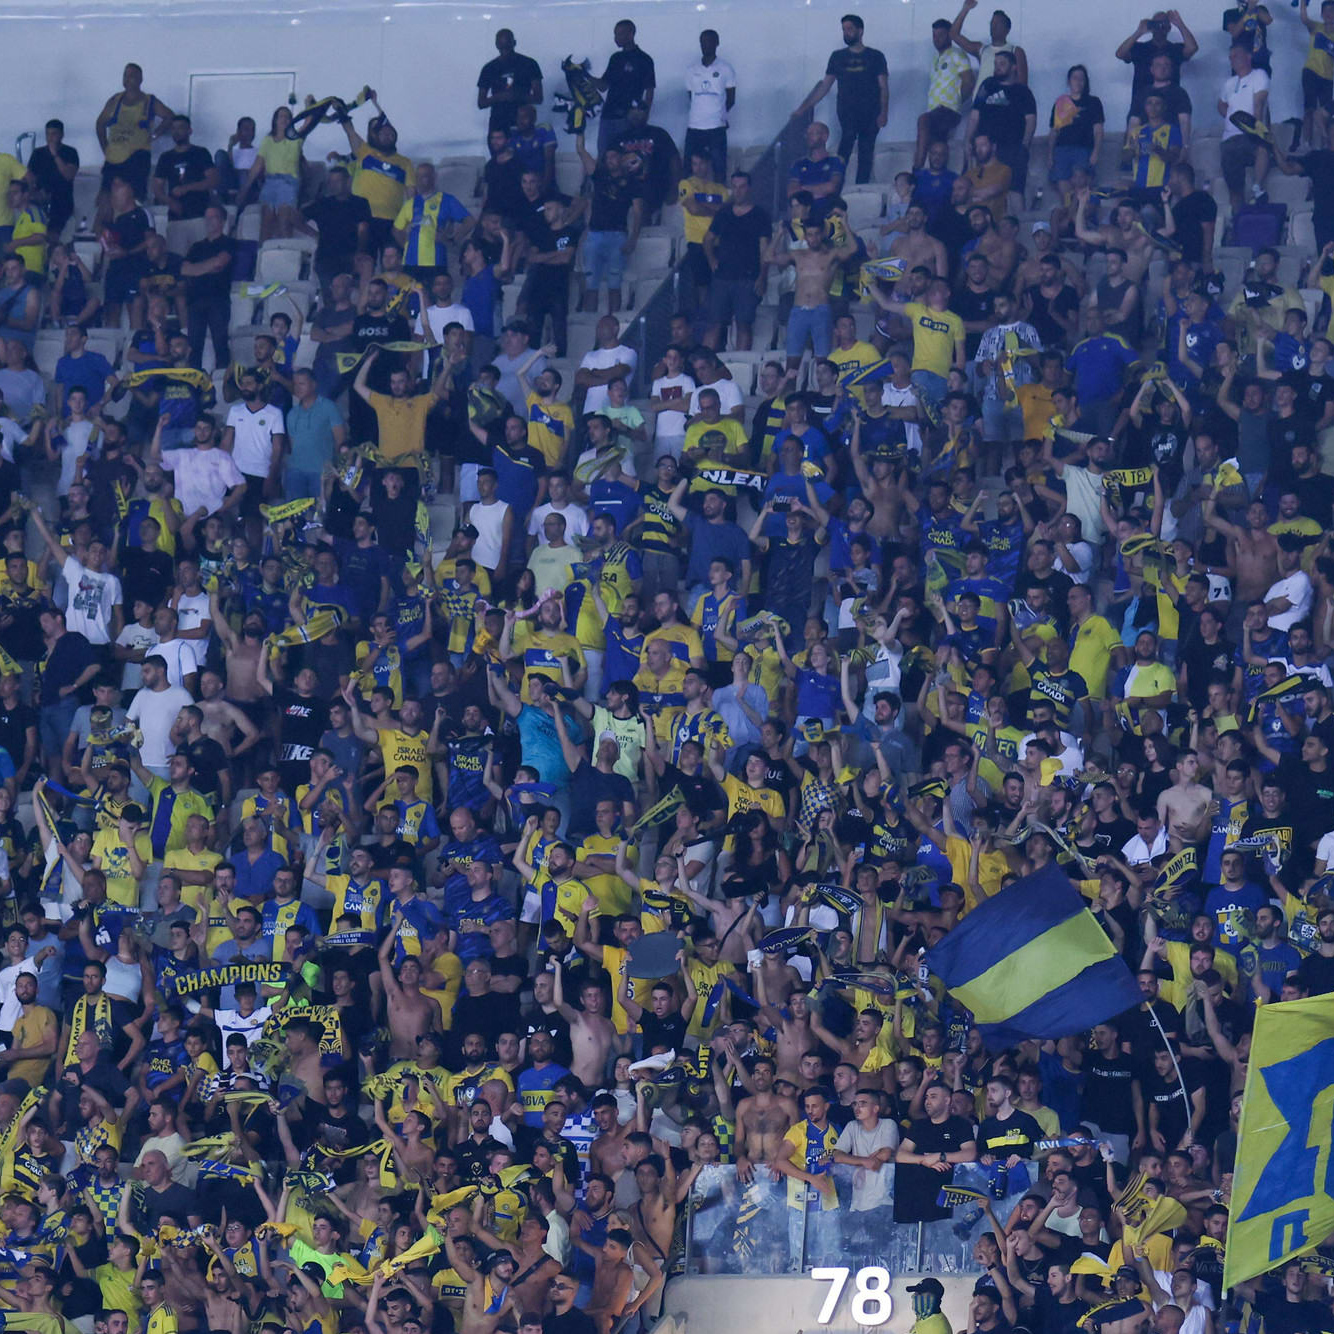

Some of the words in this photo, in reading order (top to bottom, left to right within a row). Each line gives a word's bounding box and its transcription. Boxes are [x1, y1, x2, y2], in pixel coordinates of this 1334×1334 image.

[359, 328, 388, 337] BOSS
[287, 706, 312, 718] NIKE
[397, 746, 426, 754] ISRAEL
[176, 965, 282, 996] CHAMPIONS
[1196, 1263, 1223, 1274] VANS
[812, 1267, 892, 1325] 78
